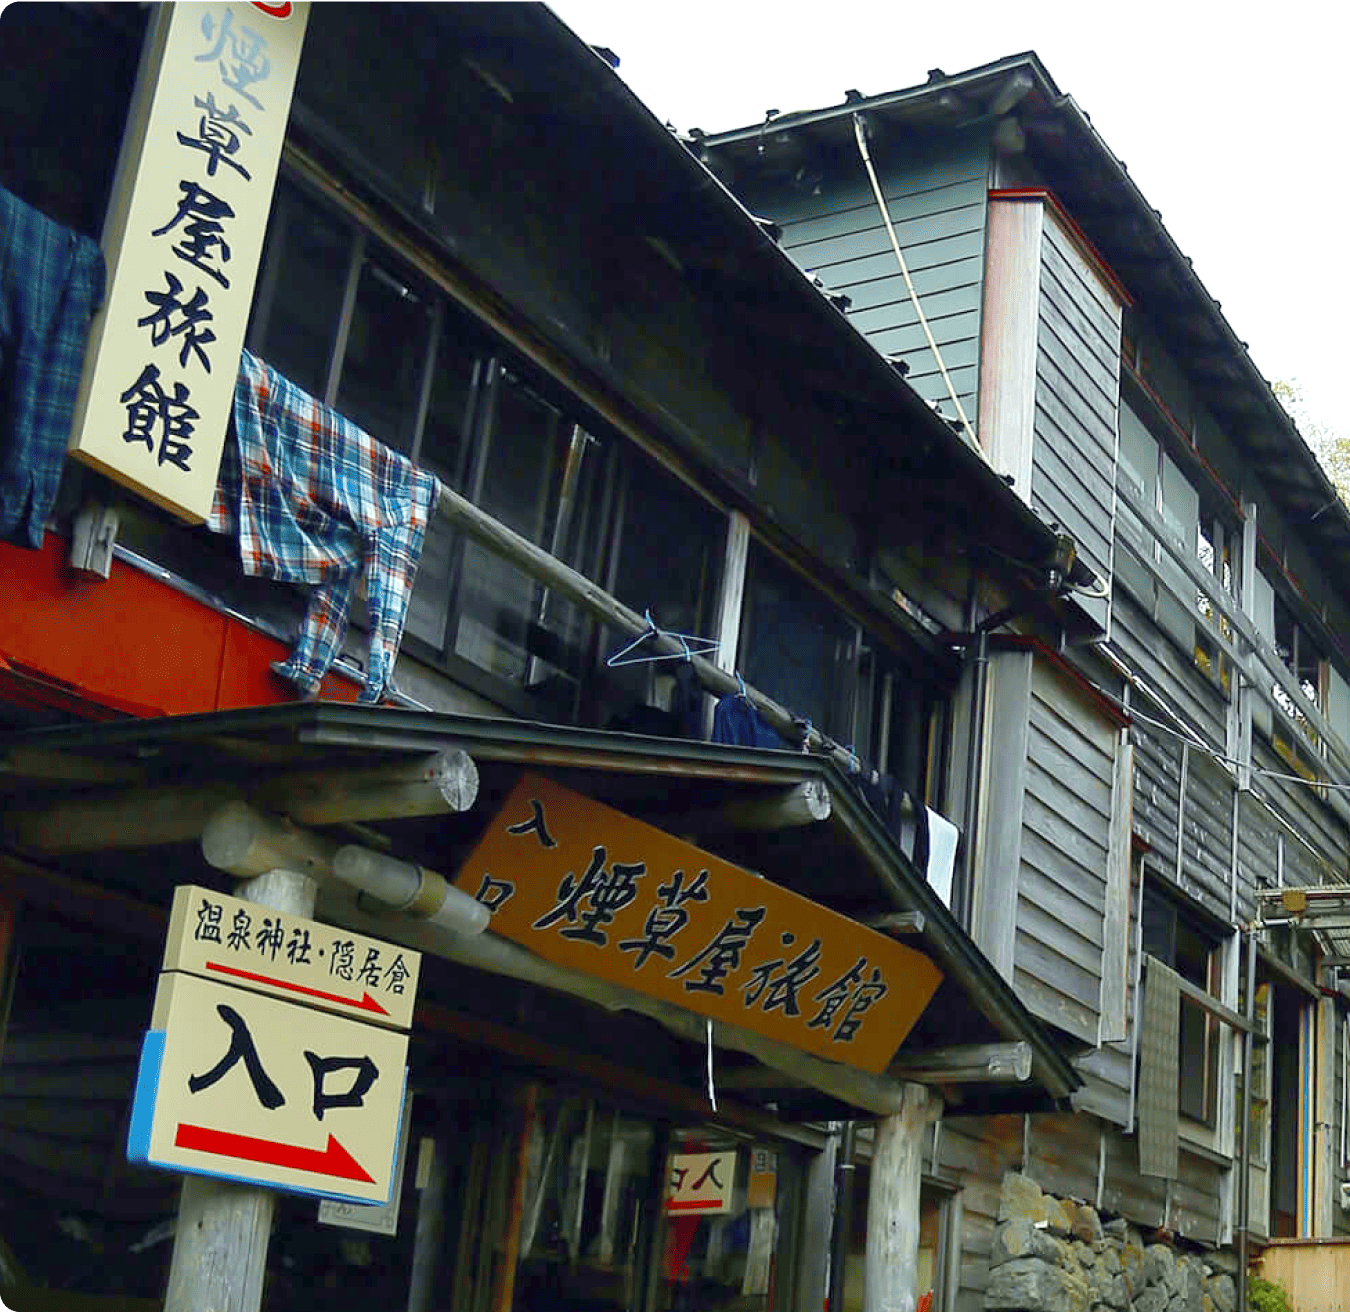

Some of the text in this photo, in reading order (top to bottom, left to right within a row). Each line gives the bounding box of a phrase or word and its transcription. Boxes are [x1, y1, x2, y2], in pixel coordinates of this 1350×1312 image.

[119, 9, 271, 473] 煙草屋旅館
[532, 845, 887, 1042] 煙草屋旅館
[188, 1003, 379, 1122] 入口
